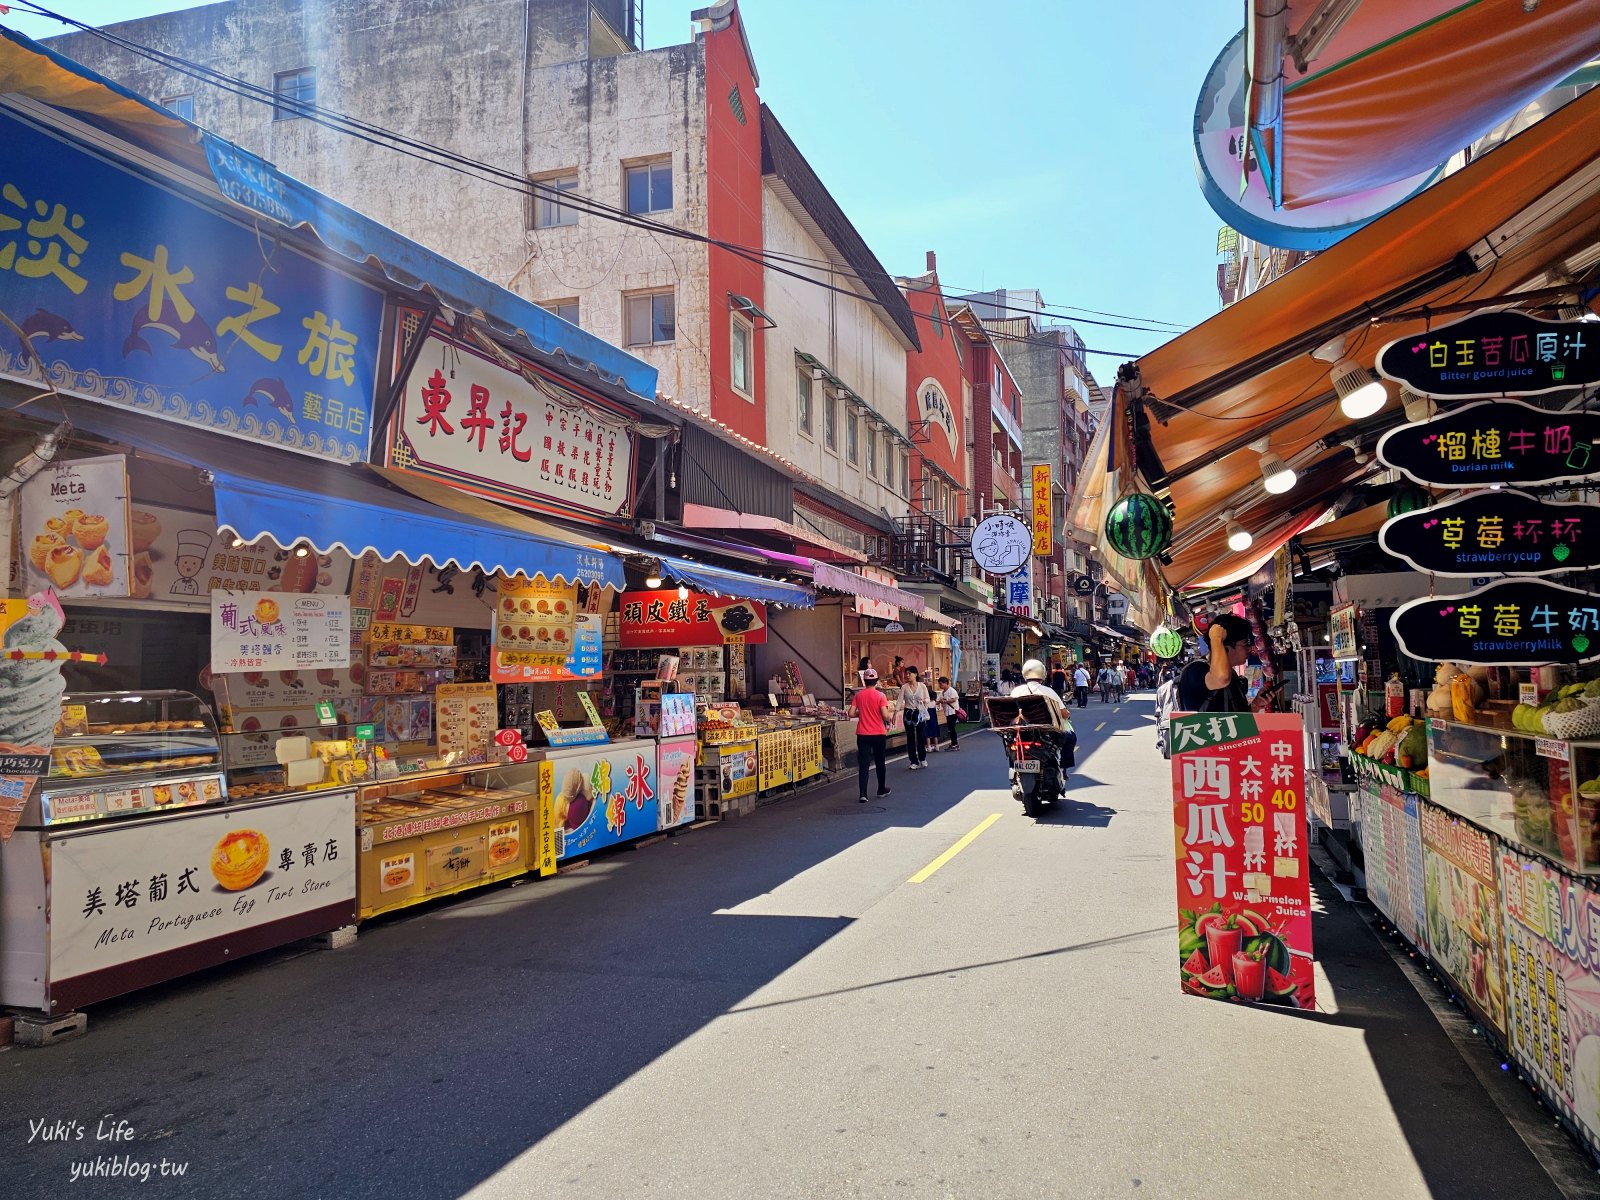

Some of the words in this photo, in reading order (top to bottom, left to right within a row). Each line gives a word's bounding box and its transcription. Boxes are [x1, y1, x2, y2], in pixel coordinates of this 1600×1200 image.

[0, 182, 359, 387] 淡水之旅
[1429, 331, 1587, 368] 白玉苦瓜原汁
[1440, 370, 1471, 381] Bitter
[1473, 368, 1505, 381] gourd
[1506, 367, 1534, 379] juice
[302, 391, 366, 435] 藝品店
[416, 368, 532, 463] 東昇記
[1437, 425, 1572, 461] 榴槤牛奶
[1452, 463, 1488, 473] Durian
[1490, 460, 1515, 471] milk
[50, 481, 87, 496] Meta
[1034, 470, 1050, 551] 新建成餅店
[1441, 515, 1582, 550] 草莓杯杯
[211, 553, 266, 575] 美味可口
[1456, 551, 1542, 563] strawberrycup
[219, 601, 287, 639] 葡式風味
[356, 617, 367, 627] 50
[622, 599, 713, 625] 頑皮鐵蛋
[1458, 603, 1600, 637] 草莓牛奶
[1473, 639, 1563, 652] strawberryMilk
[1174, 715, 1238, 751] 欠打
[1218, 738, 1262, 752] Since2012
[0, 757, 43, 769] 巧克力
[1181, 756, 1237, 899] 西瓜汁
[277, 837, 339, 873] 專賣店
[82, 867, 201, 919] 美塔葡式
[1232, 891, 1302, 906] Waermelon
[94, 927, 135, 949] Meta
[147, 905, 223, 935] Portuguese
[232, 894, 256, 915] Egg
[267, 885, 295, 904] Tart
[301, 876, 331, 894] Store
[1275, 905, 1307, 917] Juice
